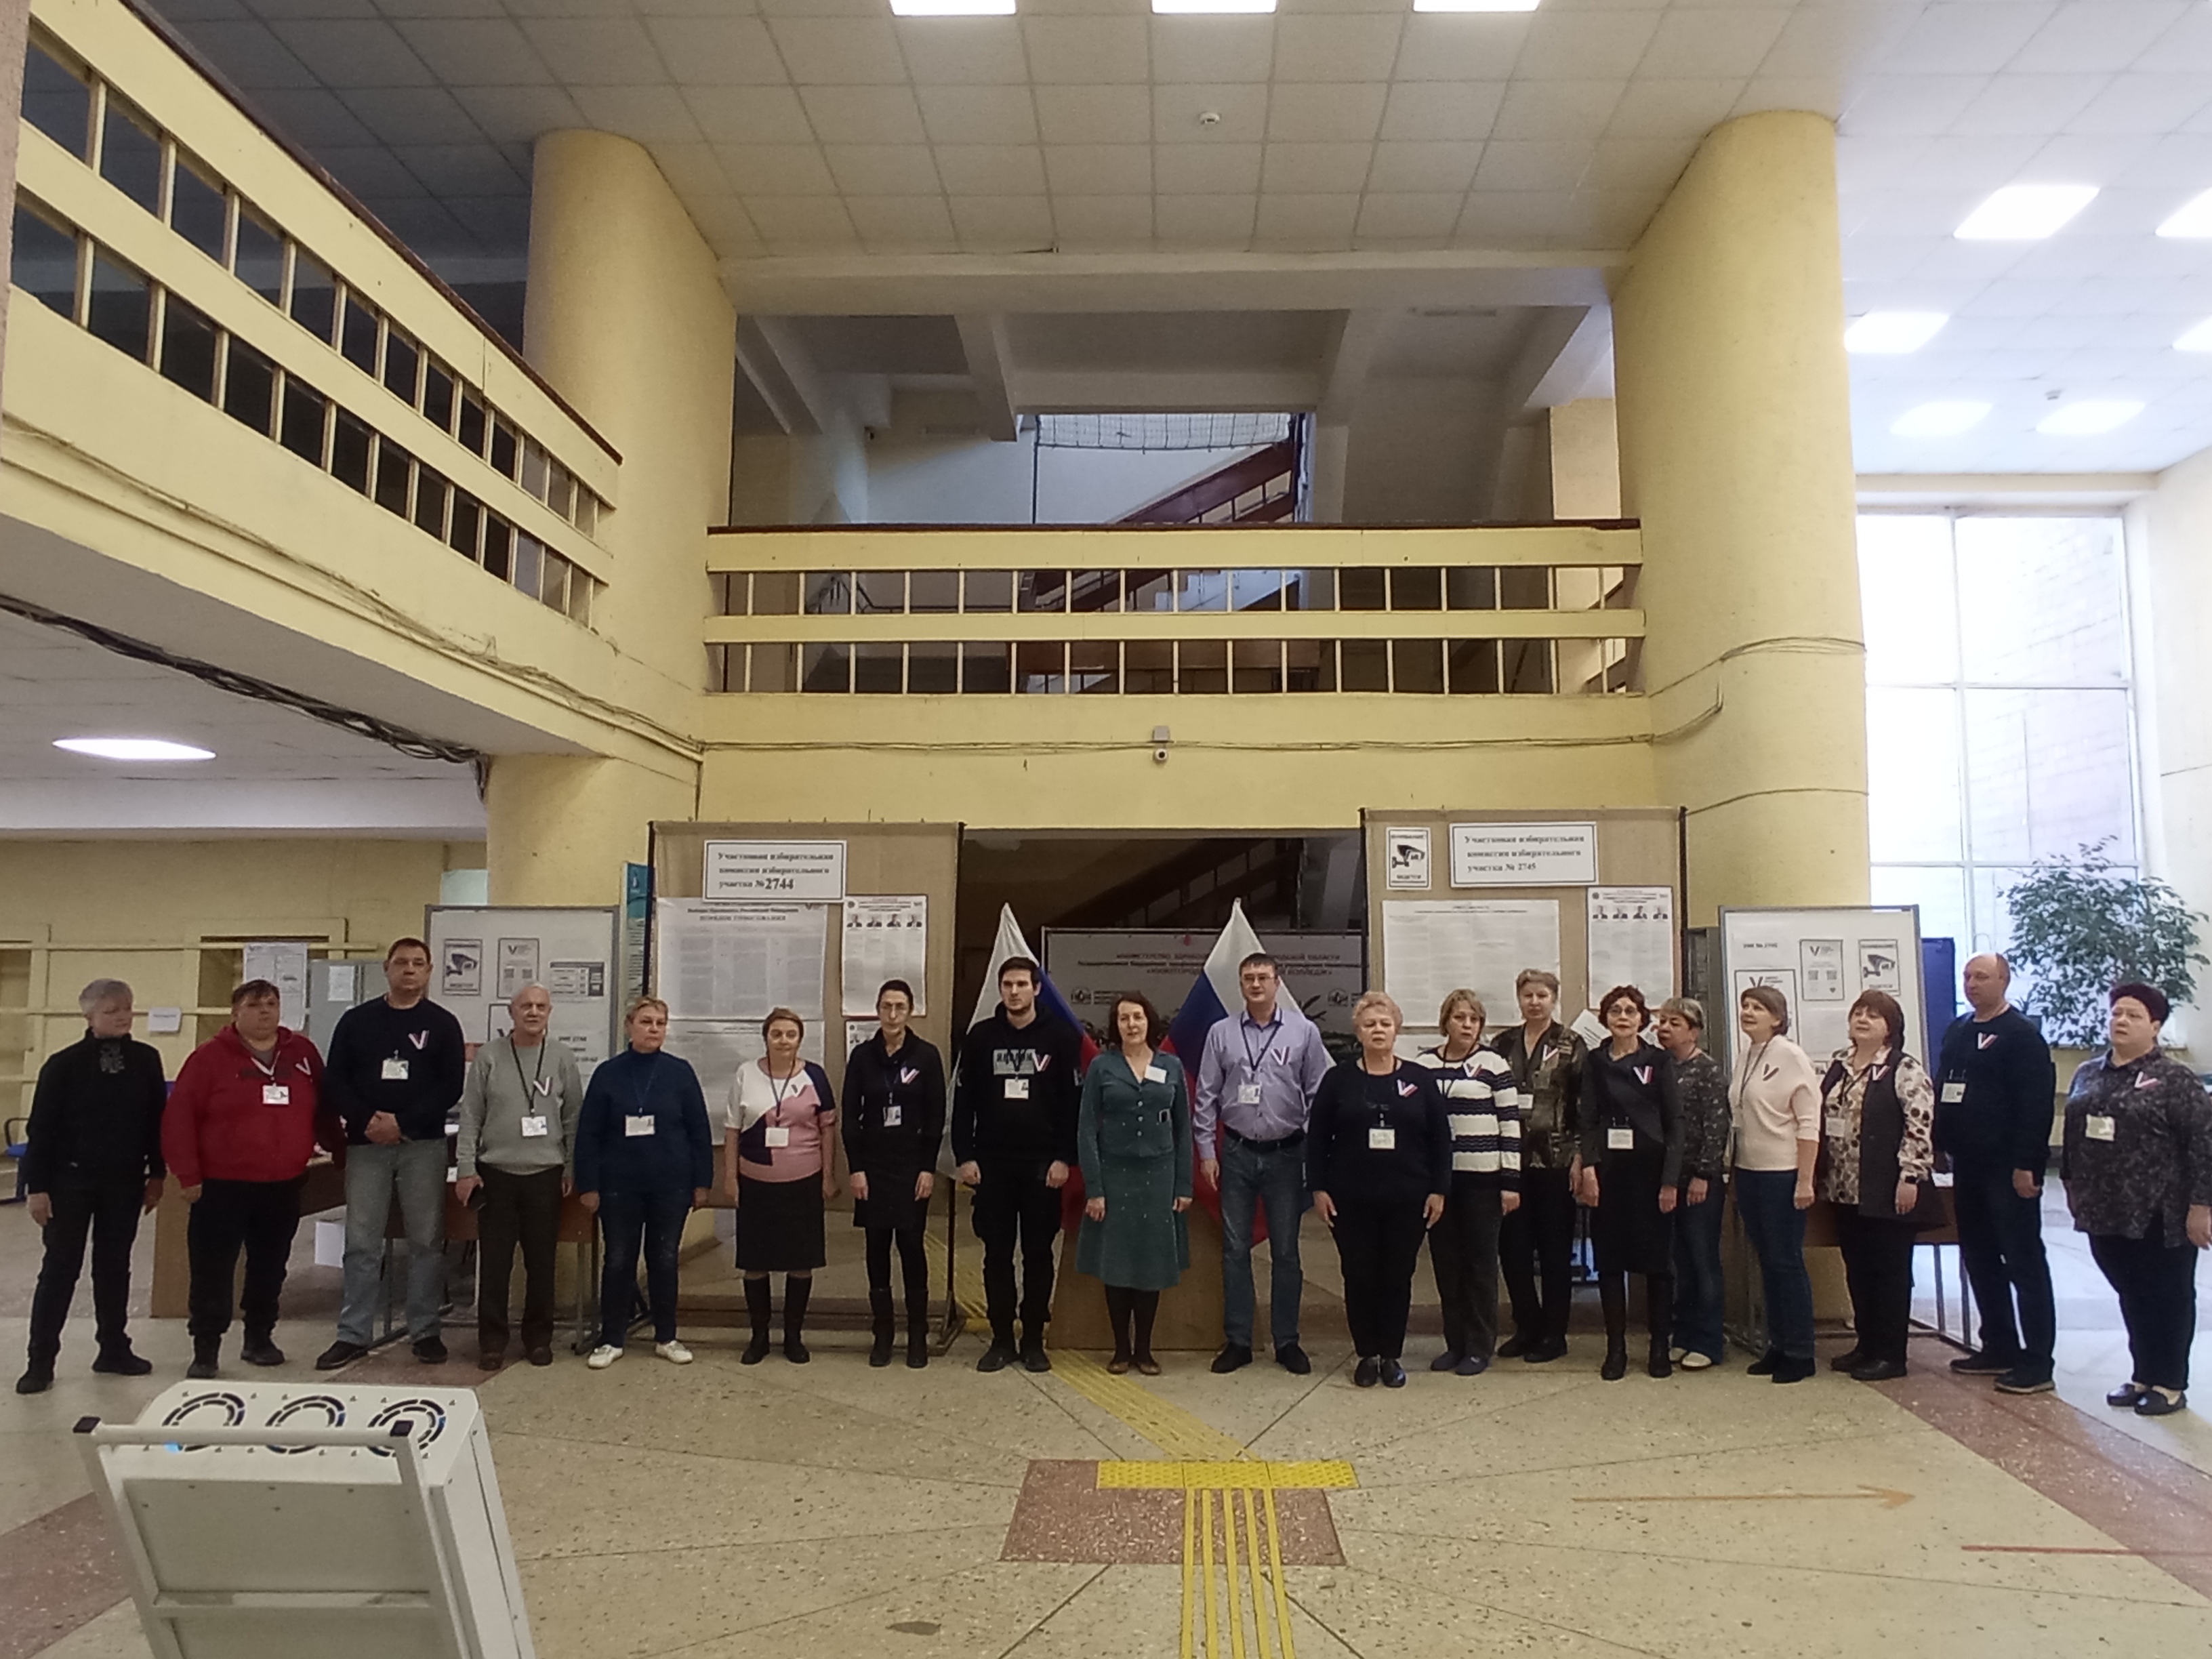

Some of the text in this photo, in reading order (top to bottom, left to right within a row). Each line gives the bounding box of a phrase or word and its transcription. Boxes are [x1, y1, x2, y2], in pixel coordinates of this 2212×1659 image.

[1464, 835, 1584, 844] Участковая избирательная
[1467, 864, 1502, 873] участка
[1517, 862, 1536, 871] 2745
